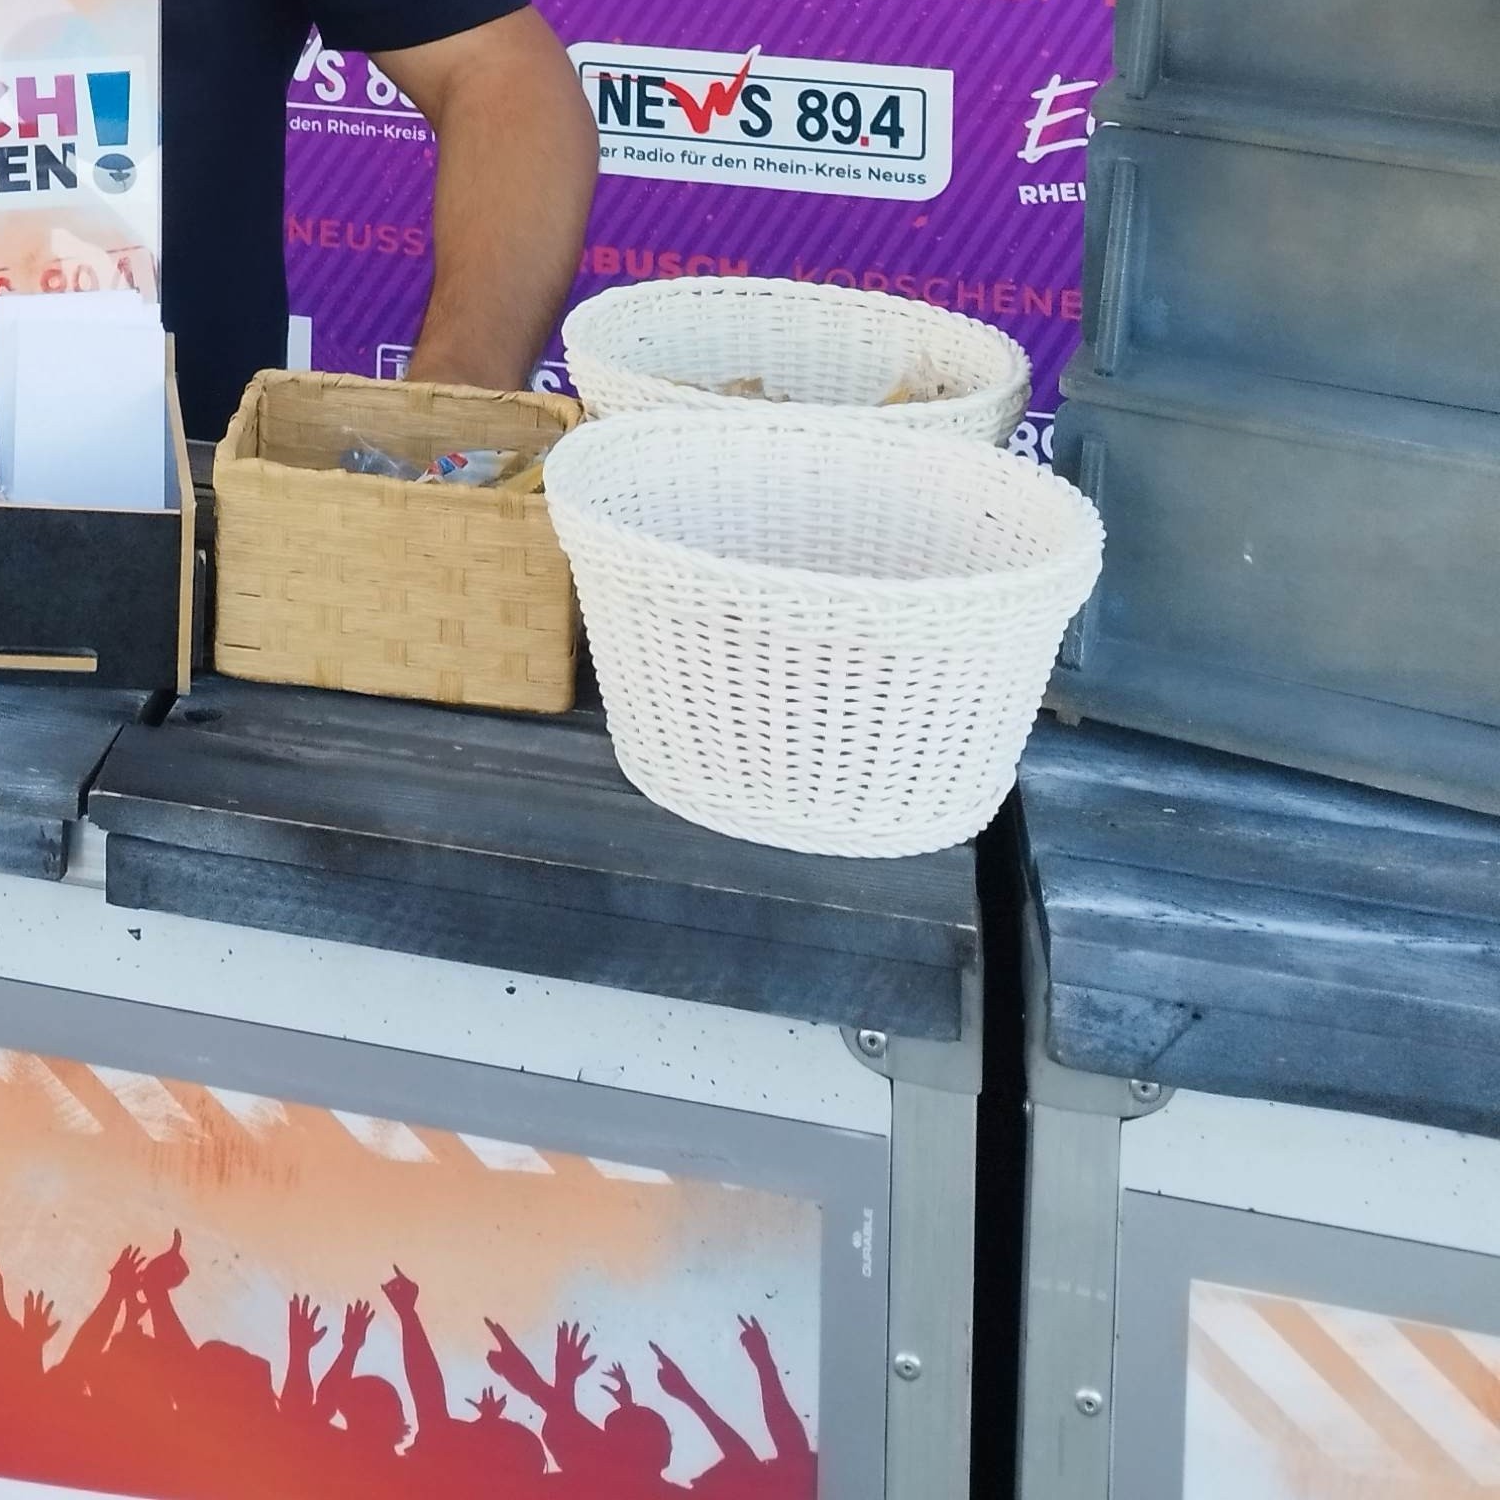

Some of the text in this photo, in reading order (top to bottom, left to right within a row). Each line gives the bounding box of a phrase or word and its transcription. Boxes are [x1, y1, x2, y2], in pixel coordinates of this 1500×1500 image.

[289, 115, 322, 133] den
[326, 117, 427, 141] Rhein-Kreis
[796, 89, 906, 150] 89.4
[623, 145, 675, 165] Radio
[680, 149, 707, 168] für
[712, 153, 748, 171] den
[753, 157, 862, 181] Rhein-Kreis
[867, 165, 927, 185] Neuss
[287, 212, 425, 257] NEUSS
[578, 244, 749, 278] BUSCH
